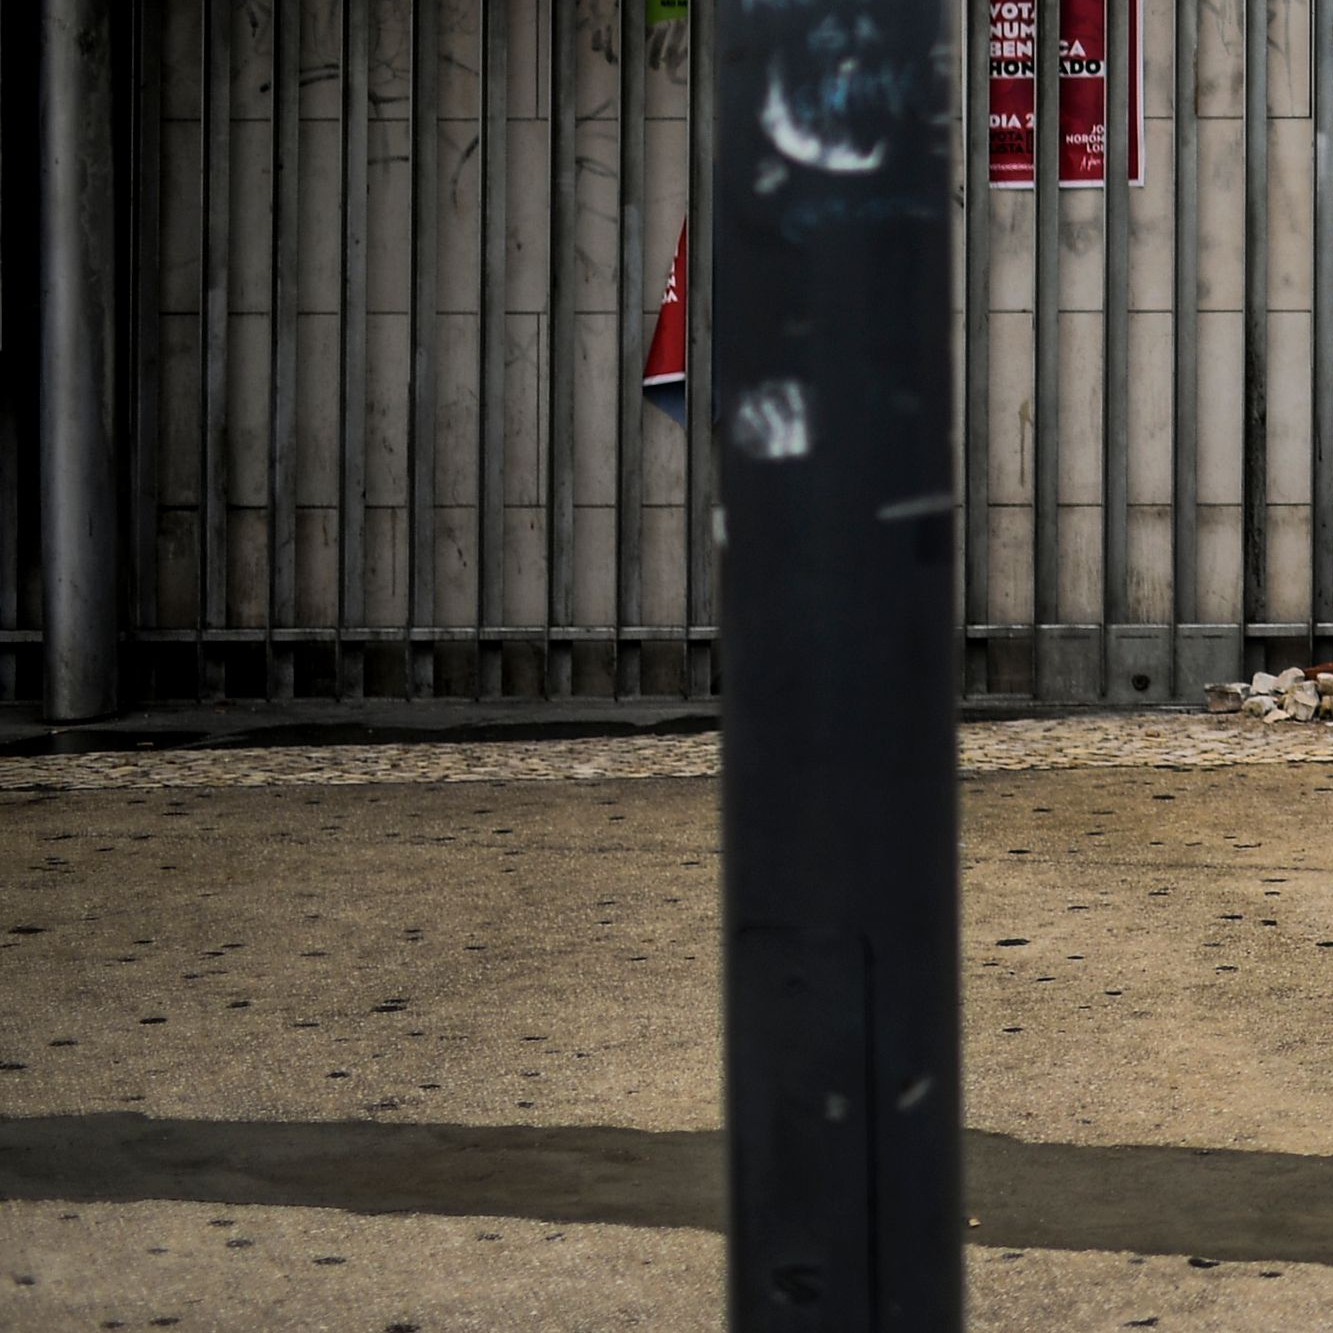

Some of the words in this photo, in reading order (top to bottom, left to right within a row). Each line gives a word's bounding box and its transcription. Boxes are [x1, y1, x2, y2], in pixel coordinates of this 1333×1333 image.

[990, 39, 1087, 57] BENCA
[990, 58, 1102, 76] HONADO
[990, 113, 1022, 128] DIA
